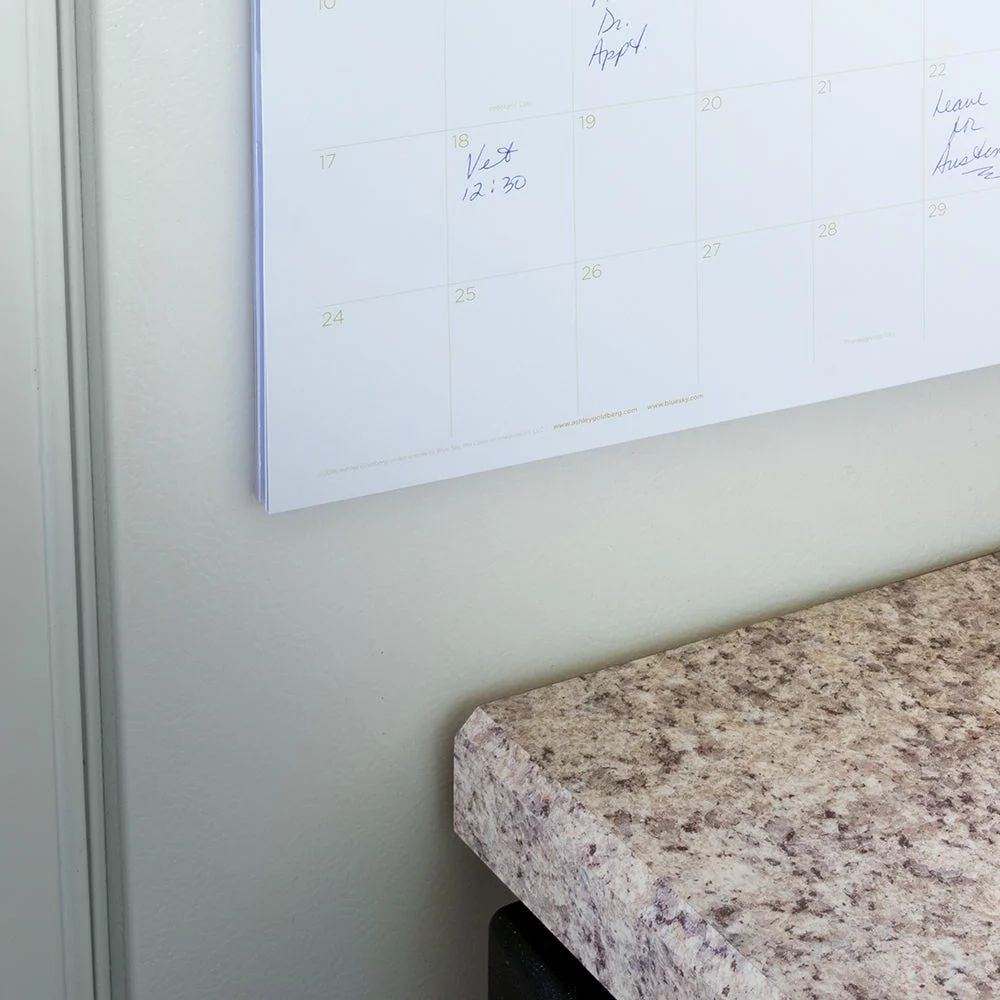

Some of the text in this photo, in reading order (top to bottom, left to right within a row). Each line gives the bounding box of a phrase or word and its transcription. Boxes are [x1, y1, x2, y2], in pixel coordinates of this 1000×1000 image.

[597, 7, 629, 35] Dr.
[319, 151, 337, 170] 17
[451, 132, 470, 149] 18
[578, 113, 597, 130] 19
[700, 95, 723, 113] 20
[816, 79, 832, 96] 21
[928, 62, 947, 79] 22
[467, 141, 518, 179] Vet
[462, 175, 526, 201] 12:30
[321, 308, 345, 329] 24
[454, 285, 477, 305] 25
[581, 263, 603, 281] 26
[701, 241, 722, 260] 27
[817, 221, 839, 239] 28
[927, 202, 948, 219] 29
